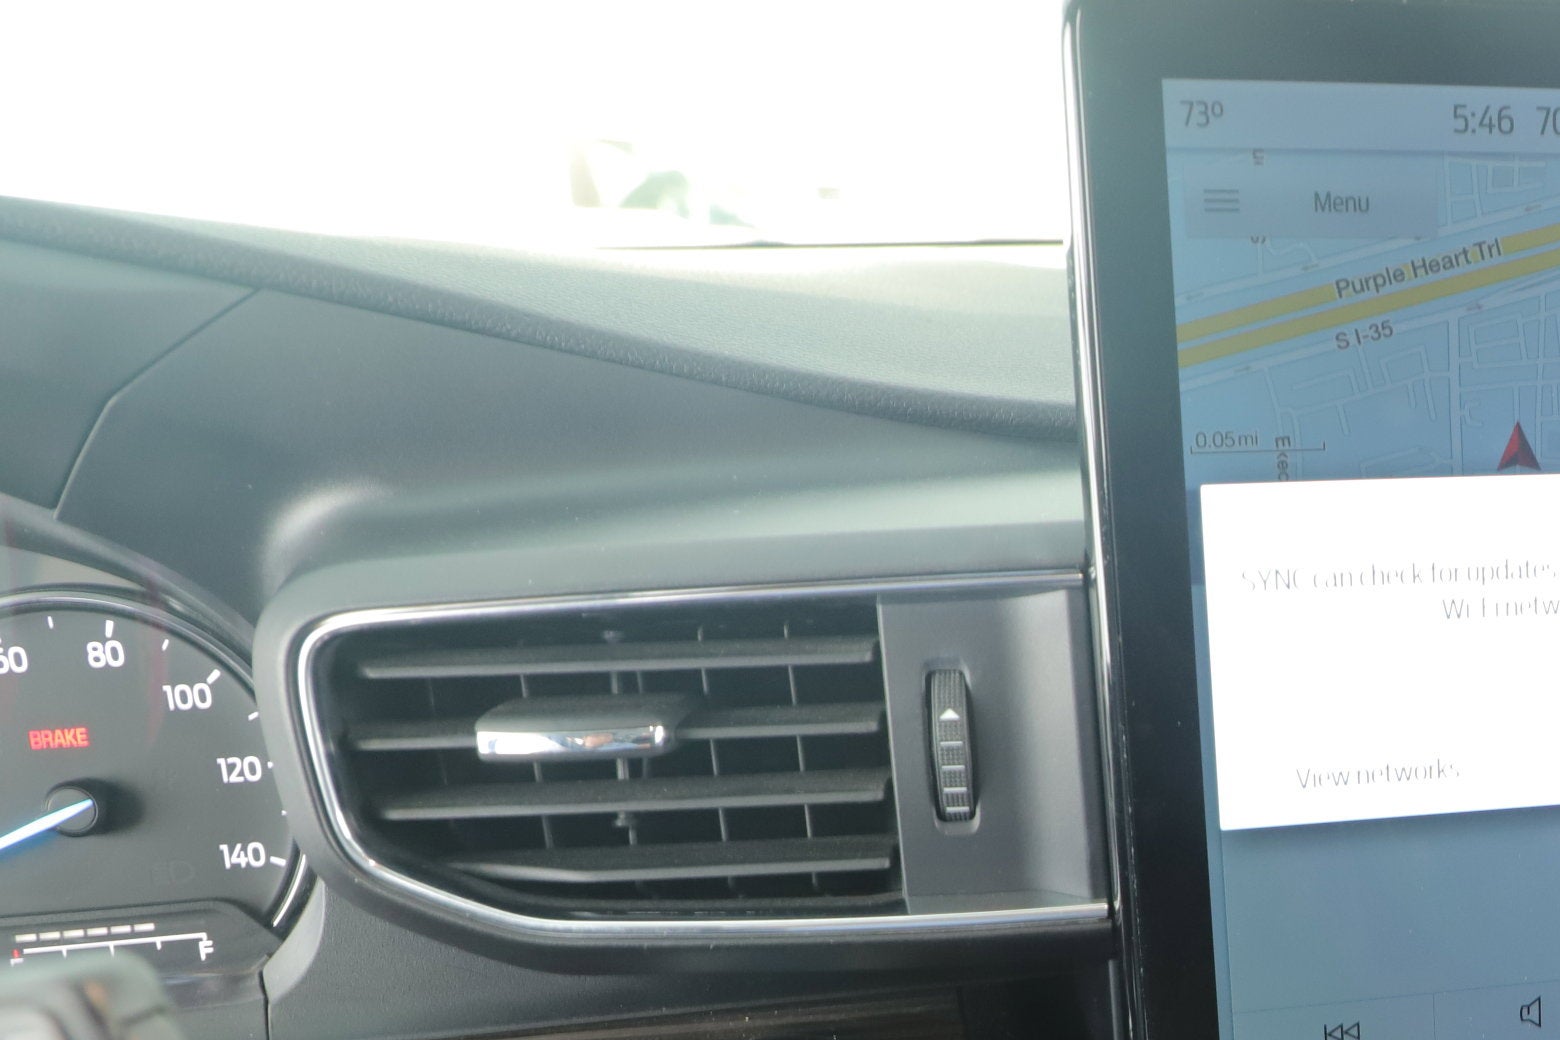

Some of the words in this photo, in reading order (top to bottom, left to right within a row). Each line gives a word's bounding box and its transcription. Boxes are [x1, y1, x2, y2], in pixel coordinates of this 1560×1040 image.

[1453, 104, 1515, 135] 5:46
[1313, 190, 1370, 213] Menu
[1335, 265, 1406, 299] Purple
[1410, 249, 1472, 280] Heart
[1335, 333, 1350, 350] S
[1355, 319, 1394, 346] I-35
[1195, 431, 1235, 449] 0.05
[1238, 430, 1258, 447] mi
[1241, 568, 1298, 591] SYNC
[1313, 570, 1353, 588] can
[1360, 563, 1422, 586] check
[1431, 562, 1460, 583] for
[86, 640, 125, 669] 80
[162, 683, 213, 712] 100
[28, 727, 90, 750] BRAKE
[216, 755, 262, 784] 120
[1296, 767, 1350, 790] View
[1357, 759, 1461, 785] networks
[219, 842, 266, 870] 140
